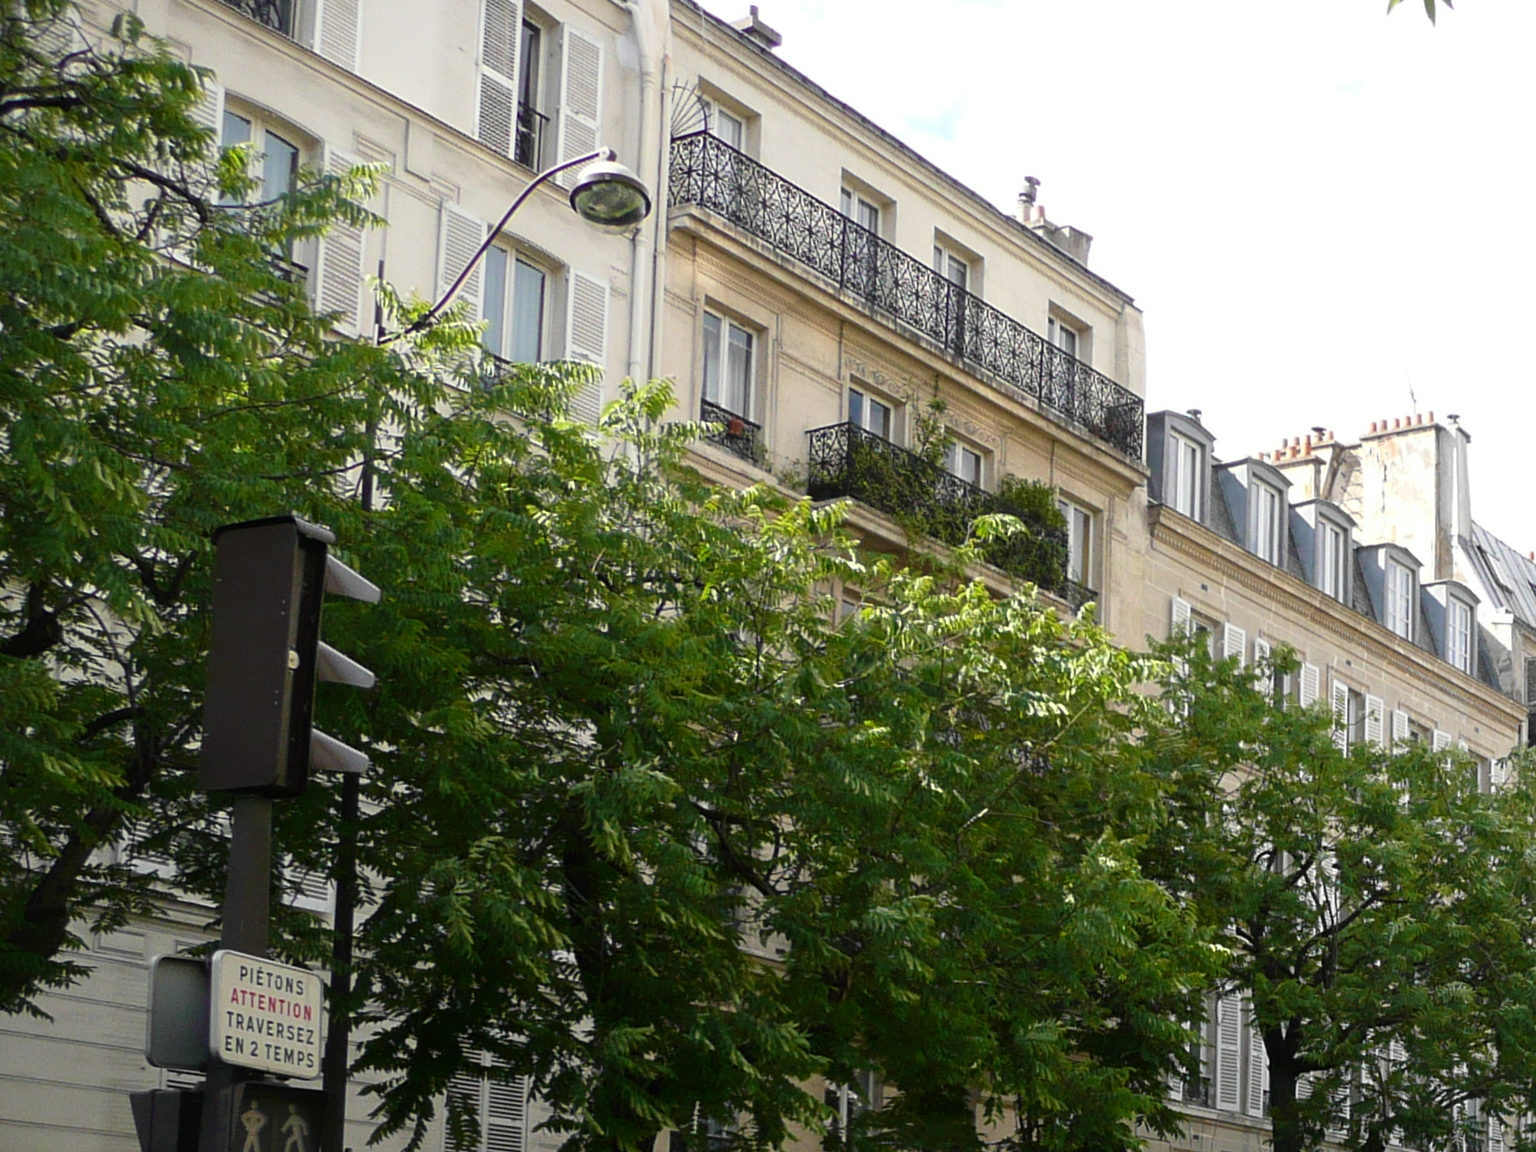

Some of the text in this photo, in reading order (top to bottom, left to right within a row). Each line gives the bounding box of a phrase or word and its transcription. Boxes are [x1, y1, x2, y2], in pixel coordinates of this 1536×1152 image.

[239, 965, 304, 996] PIÉTONS
[230, 987, 312, 1022] ATTENTION
[226, 1010, 315, 1046] TRAVERSEZ
[224, 1035, 315, 1069] EN 2 TEMPS
